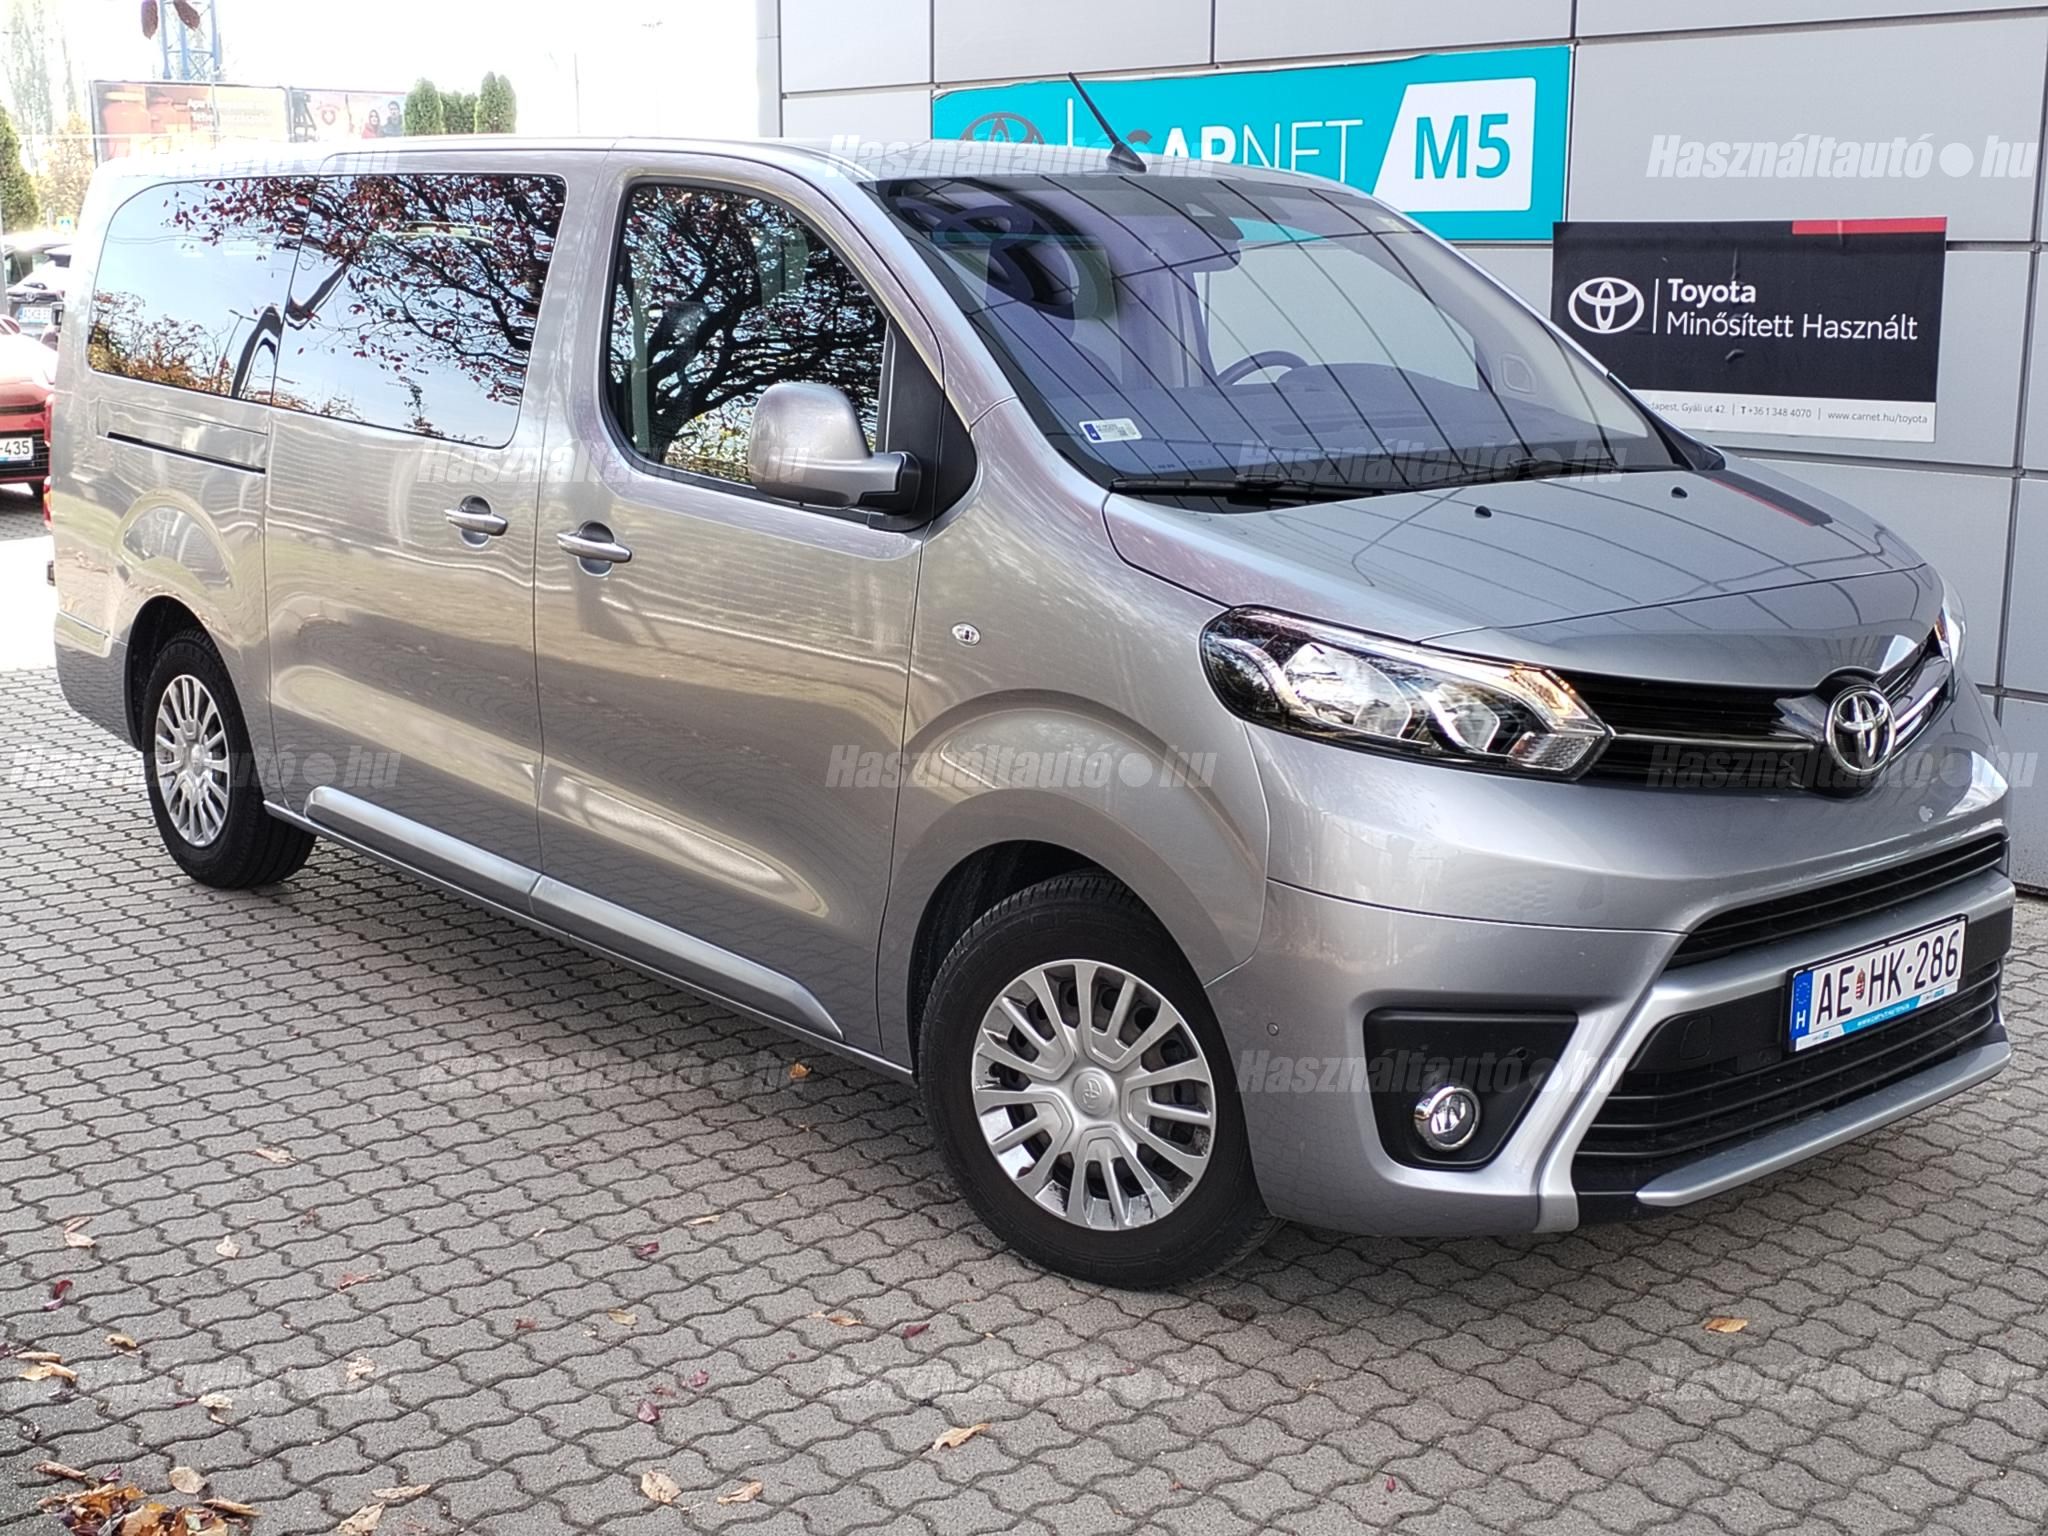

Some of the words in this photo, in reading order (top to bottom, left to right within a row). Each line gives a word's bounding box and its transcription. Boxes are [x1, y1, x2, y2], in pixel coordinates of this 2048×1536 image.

[1127, 119, 1364, 184] ARNET
[1413, 113, 1511, 180] M5
[1667, 278, 1757, 308] Toyota
[1667, 311, 1794, 338] Minősített
[1802, 313, 1918, 340] Használt
[1740, 406, 1747, 415] T
[1790, 408, 1812, 419] 4070
[1827, 411, 1928, 425] www.carnet.hu/toyota
[1816, 965, 1855, 1025] AE
[1795, 1009, 1807, 1030] H
